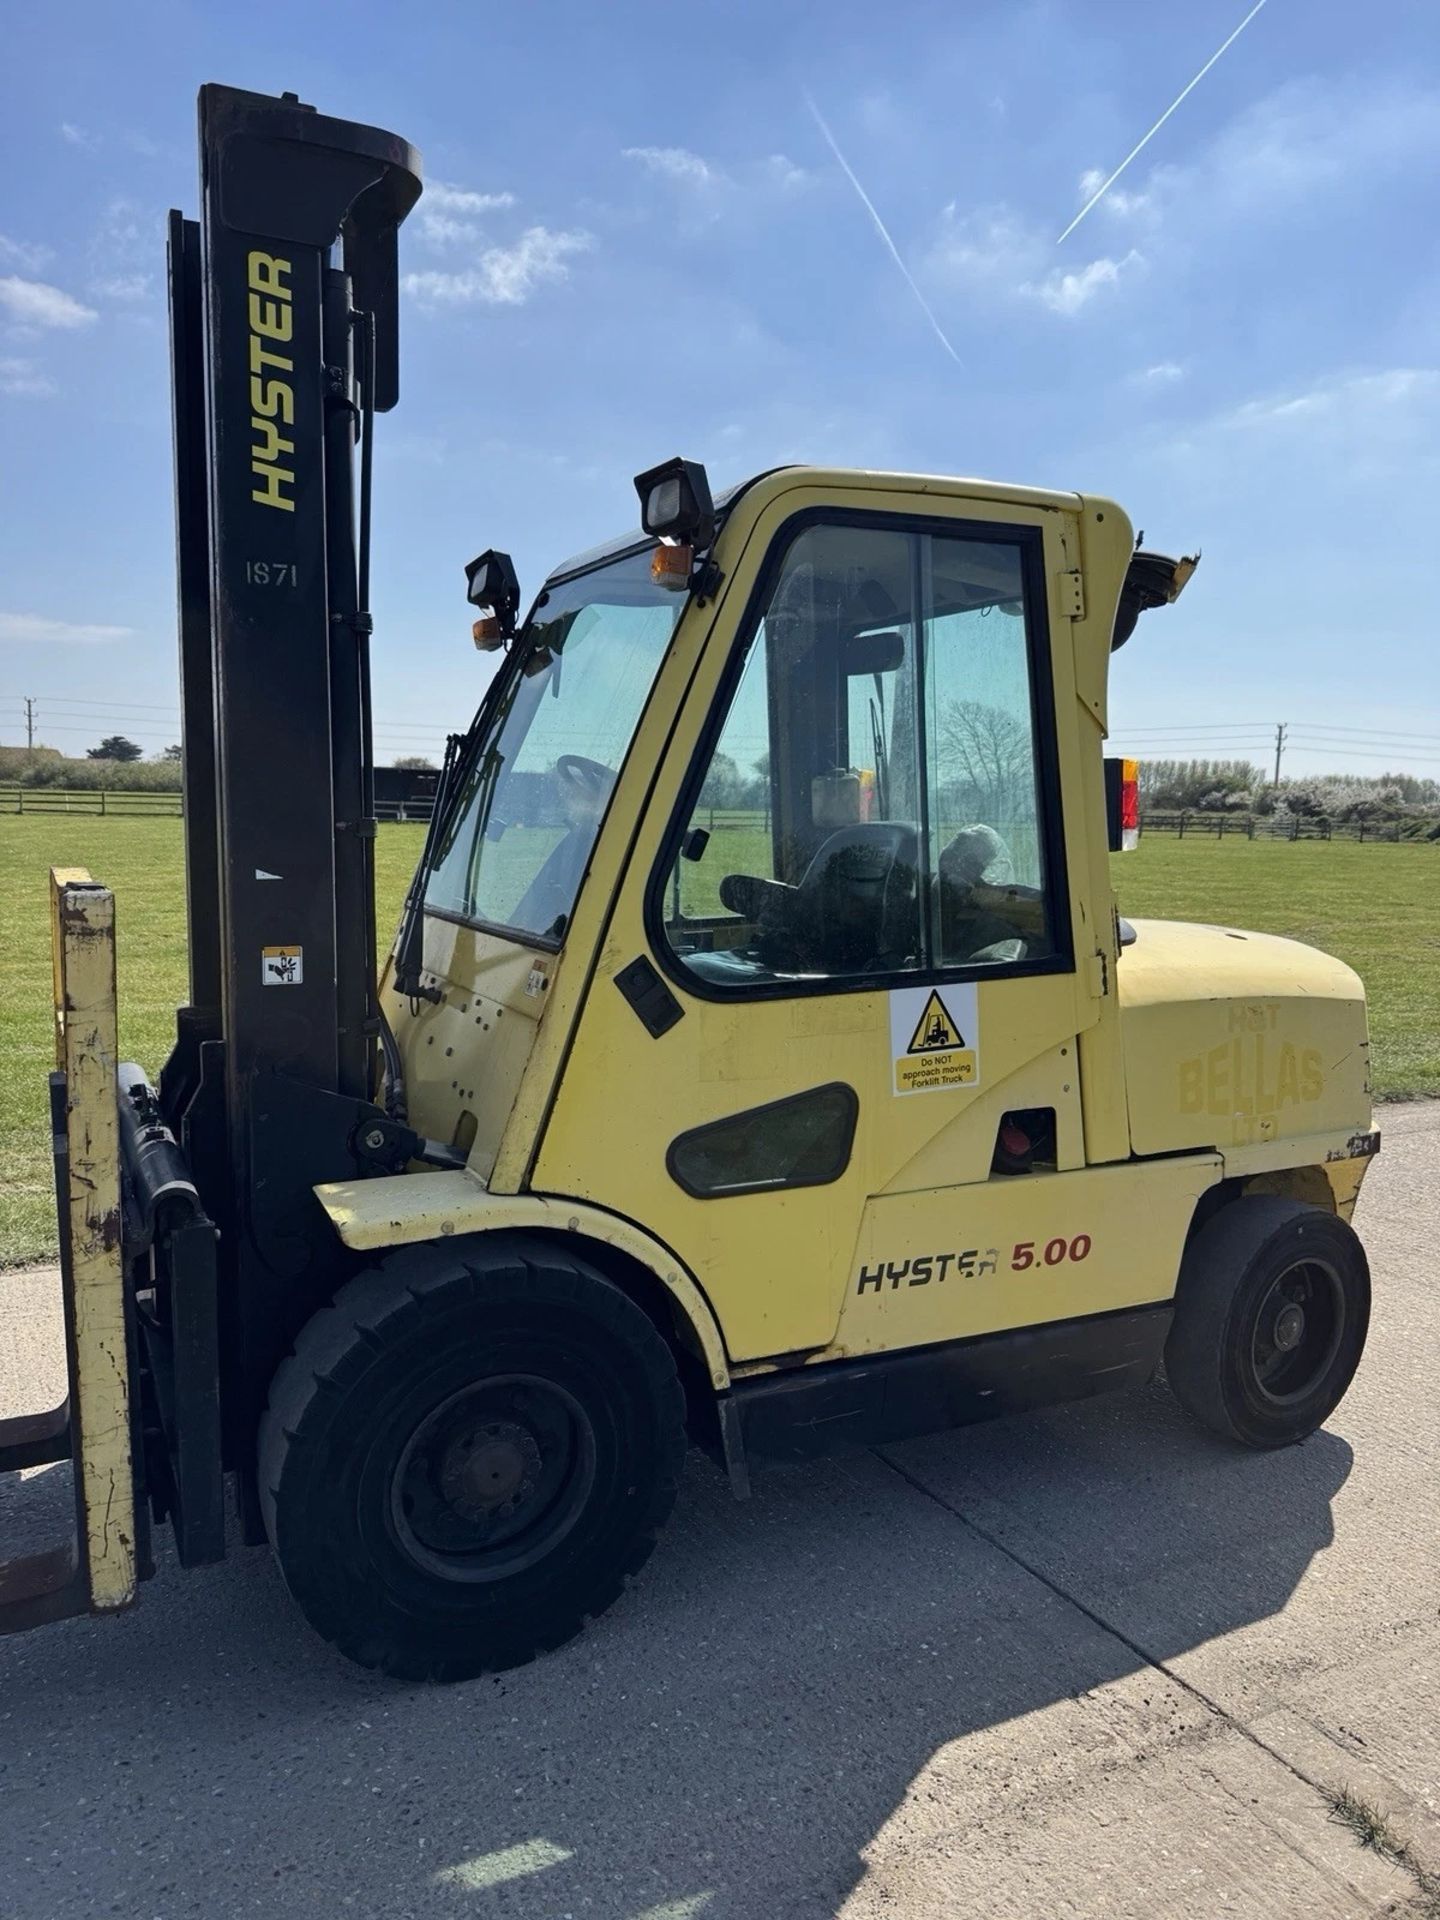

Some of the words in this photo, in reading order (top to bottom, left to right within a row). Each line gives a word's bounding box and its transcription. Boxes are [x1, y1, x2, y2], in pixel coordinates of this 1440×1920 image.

[248, 250, 295, 512] HYSTER
[903, 1067, 940, 1080] approach
[942, 1064, 971, 1074] moving
[921, 1058, 933, 1067] Do
[935, 1055, 952, 1065] NOT
[912, 1077, 939, 1088] Forklift
[941, 1074, 963, 1084] Truck
[1179, 1034, 1324, 1116] BELLAS
[1011, 1234, 1091, 1271] 5.00
